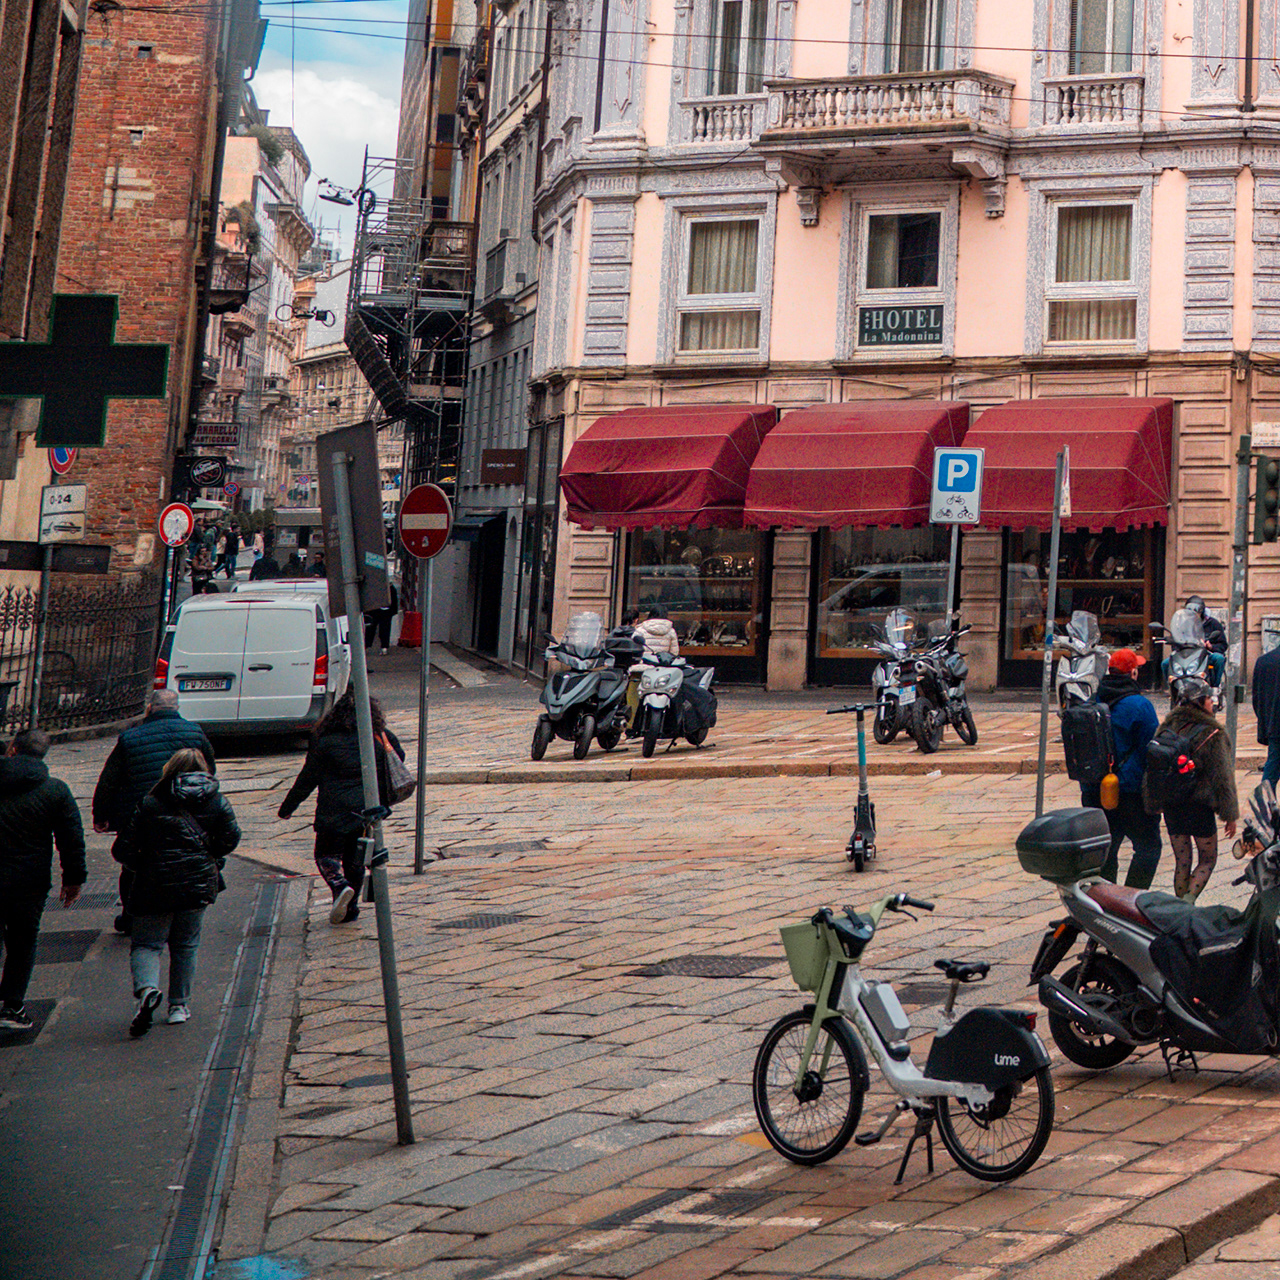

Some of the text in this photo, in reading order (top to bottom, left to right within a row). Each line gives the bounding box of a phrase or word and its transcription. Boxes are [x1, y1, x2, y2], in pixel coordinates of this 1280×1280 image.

[872, 309, 940, 329] HOTEL
[864, 331, 940, 342] La Madonnina
[947, 459, 970, 487] P
